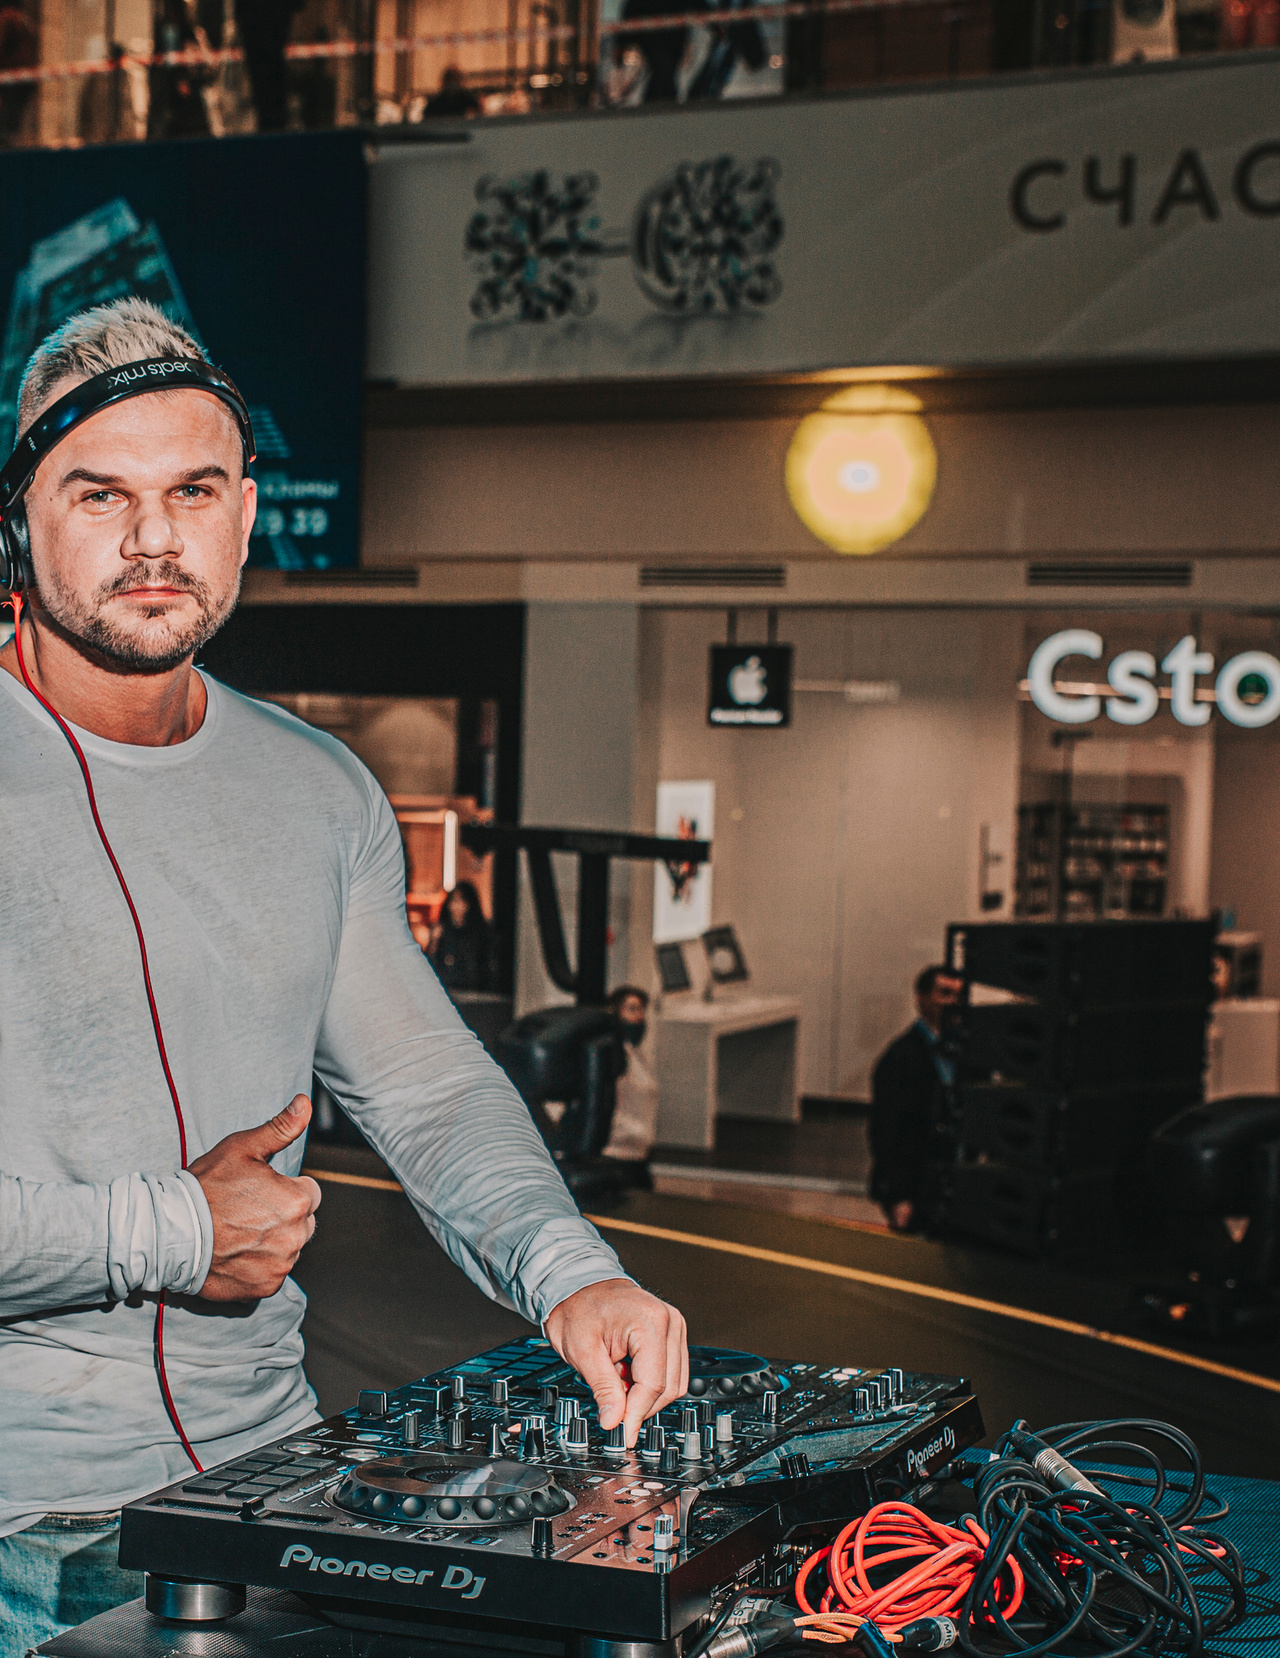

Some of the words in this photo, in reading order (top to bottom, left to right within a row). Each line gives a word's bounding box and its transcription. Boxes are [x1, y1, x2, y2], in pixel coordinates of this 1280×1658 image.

[1027, 628, 1280, 728] Csto
[906, 1437, 943, 1473] Pioneer
[280, 1544, 434, 1585] Pioneer
